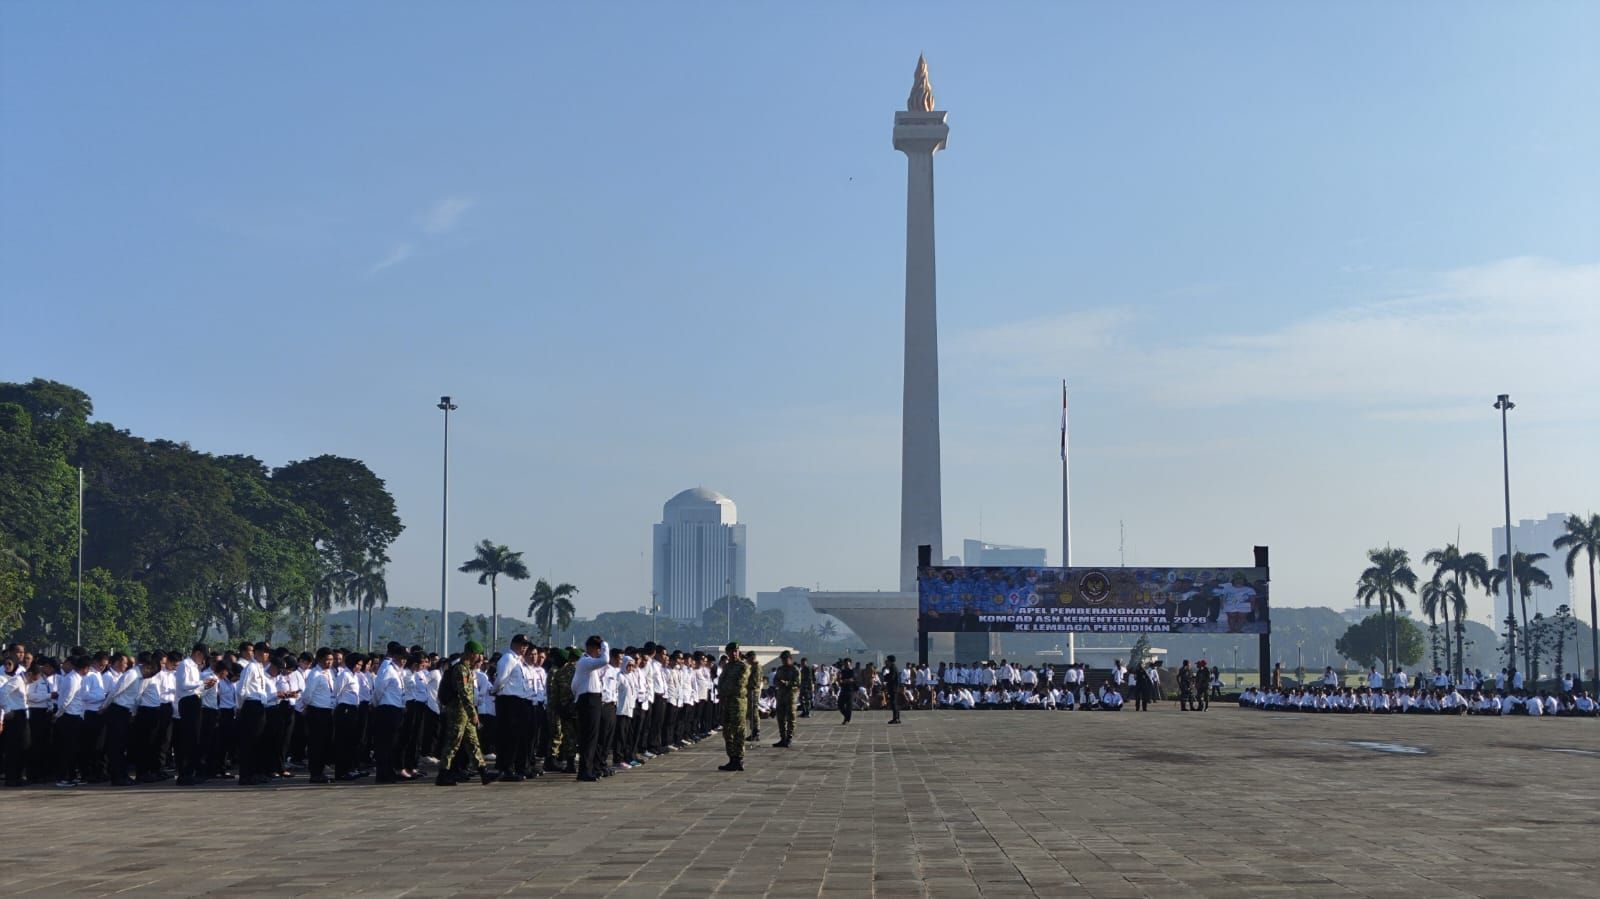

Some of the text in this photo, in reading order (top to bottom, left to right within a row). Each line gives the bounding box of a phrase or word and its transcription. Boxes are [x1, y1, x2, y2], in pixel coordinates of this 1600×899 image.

[1051, 607, 1166, 615] PEMBERANGKATAN
[978, 615, 1032, 623] KOMCAD
[1035, 615, 1060, 623] ASN
[1015, 623, 1170, 632] KE LEMBAGA PENDIDIKAN
